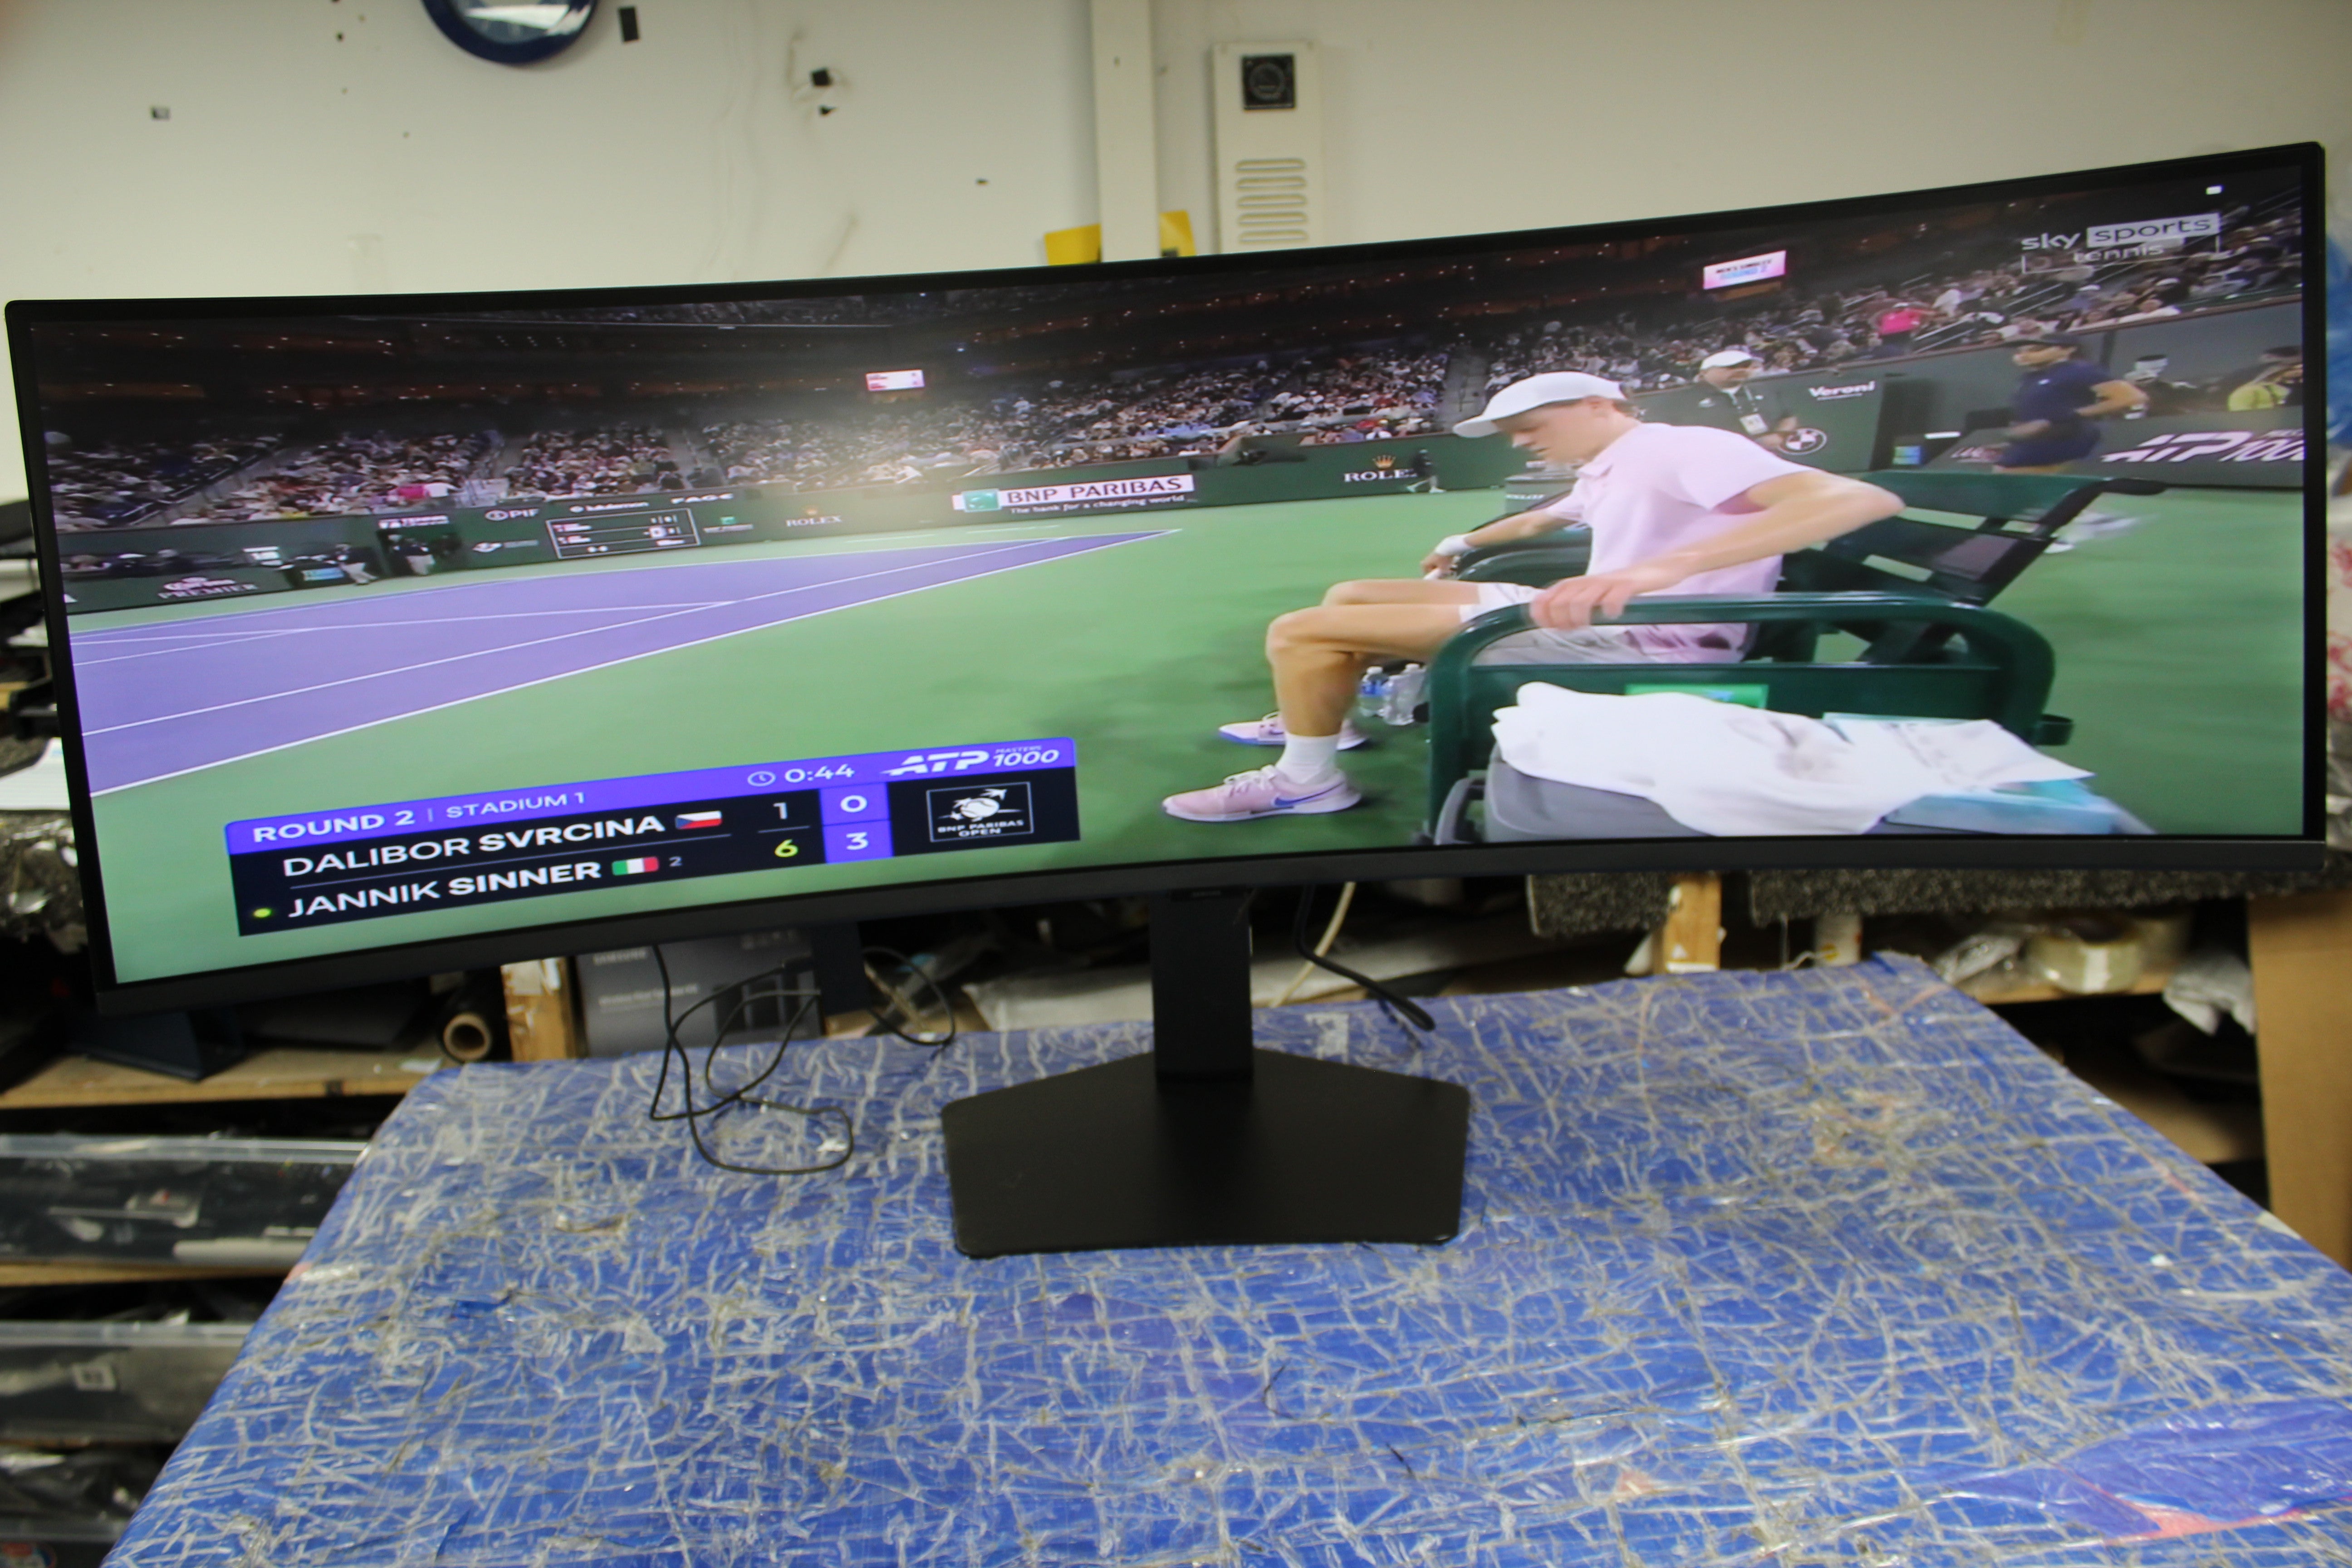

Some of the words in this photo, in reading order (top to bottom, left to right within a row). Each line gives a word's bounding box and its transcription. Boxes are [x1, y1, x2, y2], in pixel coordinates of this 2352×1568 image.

[2021, 232, 2081, 250] sky
[2095, 218, 2211, 242] sports
[2073, 243, 2165, 263] tennis
[2102, 431, 2253, 463] ATP
[1007, 488, 1057, 504] BNP
[1070, 478, 1182, 499] PARIBAS
[785, 764, 855, 783] 0:44
[881, 750, 990, 776] ATP
[993, 750, 1059, 767] 1000
[446, 794, 567, 818] STADIUM
[574, 792, 585, 804] 1
[773, 802, 788, 819] 1
[840, 795, 867, 813] 0
[254, 814, 384, 843] ROUND
[395, 810, 415, 826] 2
[958, 828, 1001, 837] OPEN
[969, 819, 1024, 830] PARIBAS
[283, 838, 470, 877] DALIBOR
[479, 815, 666, 852] SVRCINA
[774, 839, 798, 858] 6
[846, 832, 868, 850] 3
[288, 881, 441, 918] JANNIK
[448, 862, 601, 896] SINNER
[669, 856, 682, 867] 2
